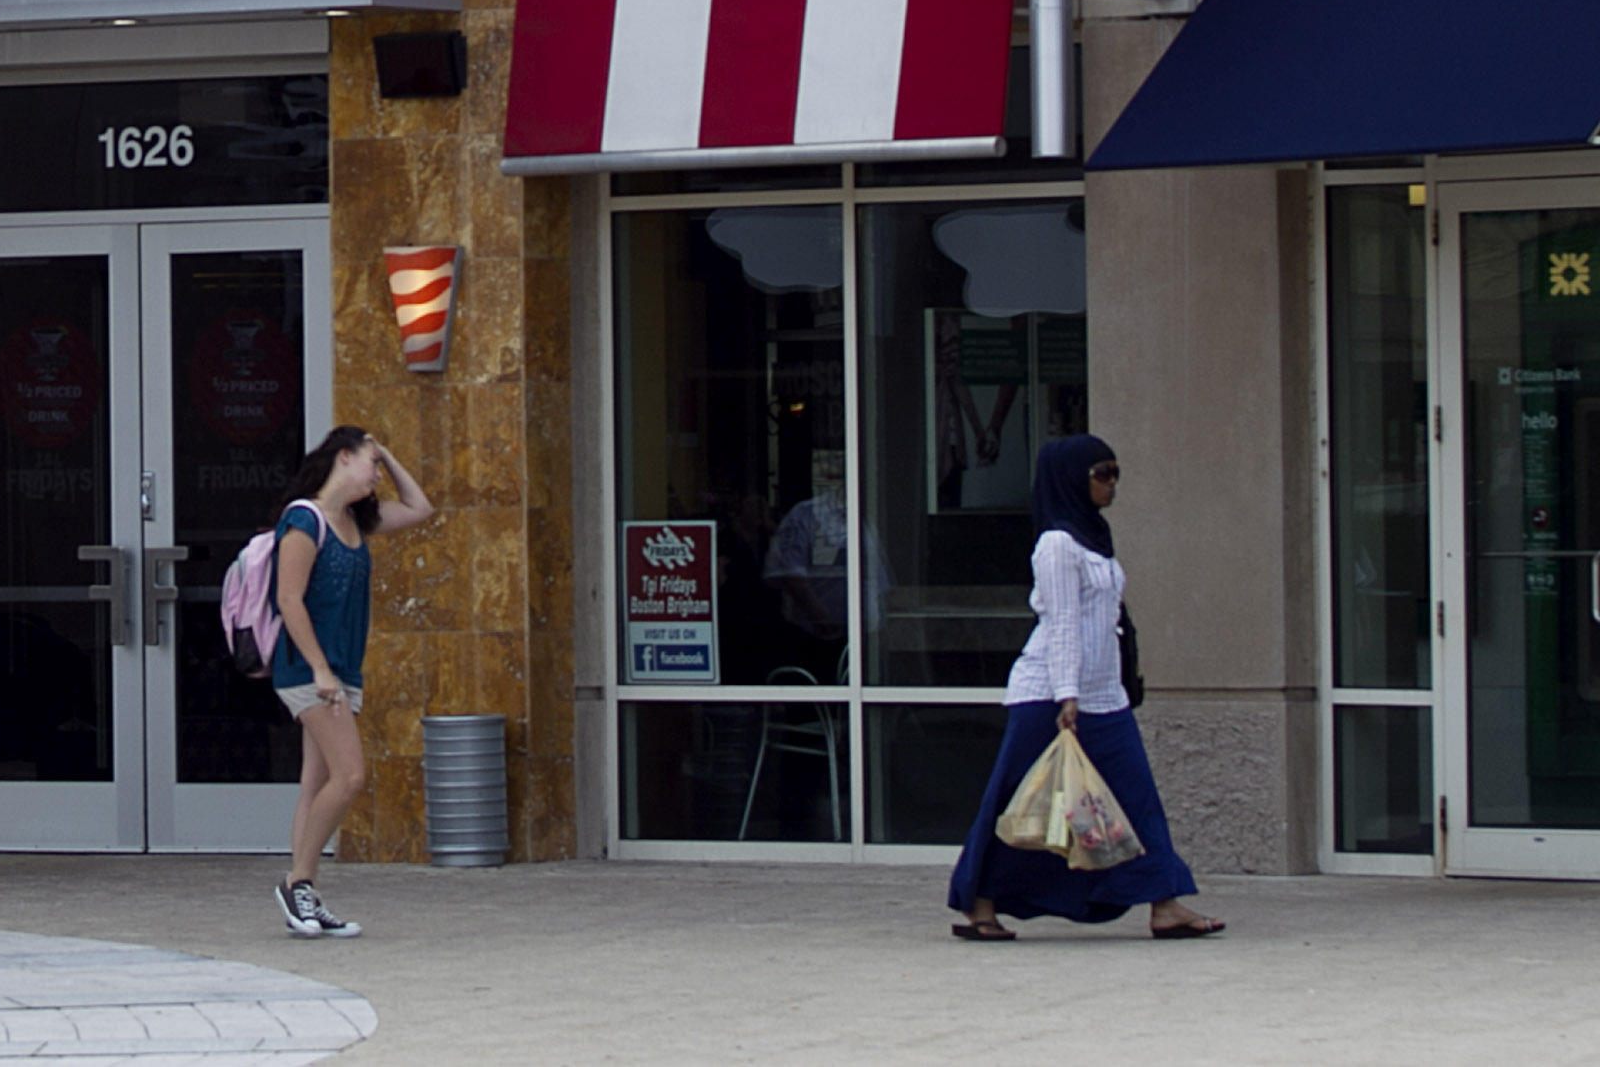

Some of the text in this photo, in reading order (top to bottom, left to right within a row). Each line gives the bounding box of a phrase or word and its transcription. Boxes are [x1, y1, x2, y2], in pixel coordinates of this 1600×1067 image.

[98, 125, 194, 167] 1626
[1514, 367, 1581, 383] Citizens Bank
[1521, 410, 1558, 429] hello
[660, 575, 697, 596] Fridays
[630, 596, 710, 618] Boston Brigham
[643, 629, 697, 640] VISIT US ON
[660, 650, 705, 665] facebook
